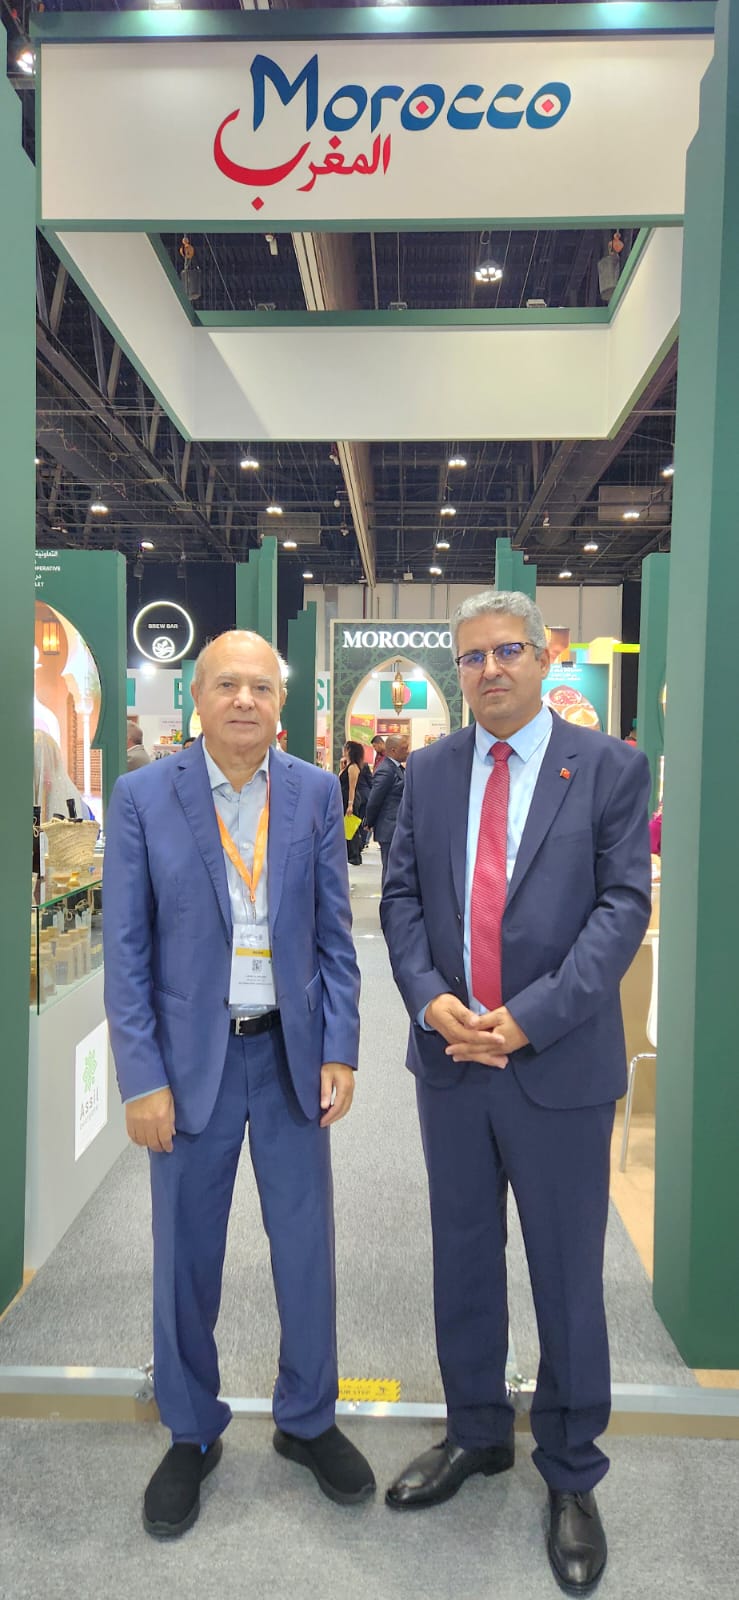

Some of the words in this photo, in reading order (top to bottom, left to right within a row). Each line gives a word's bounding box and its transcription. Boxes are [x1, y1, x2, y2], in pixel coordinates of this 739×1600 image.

[250, 54, 571, 133] Morocco
[213, 108, 391, 211] المغرب
[342, 630, 453, 649] MOROCCO
